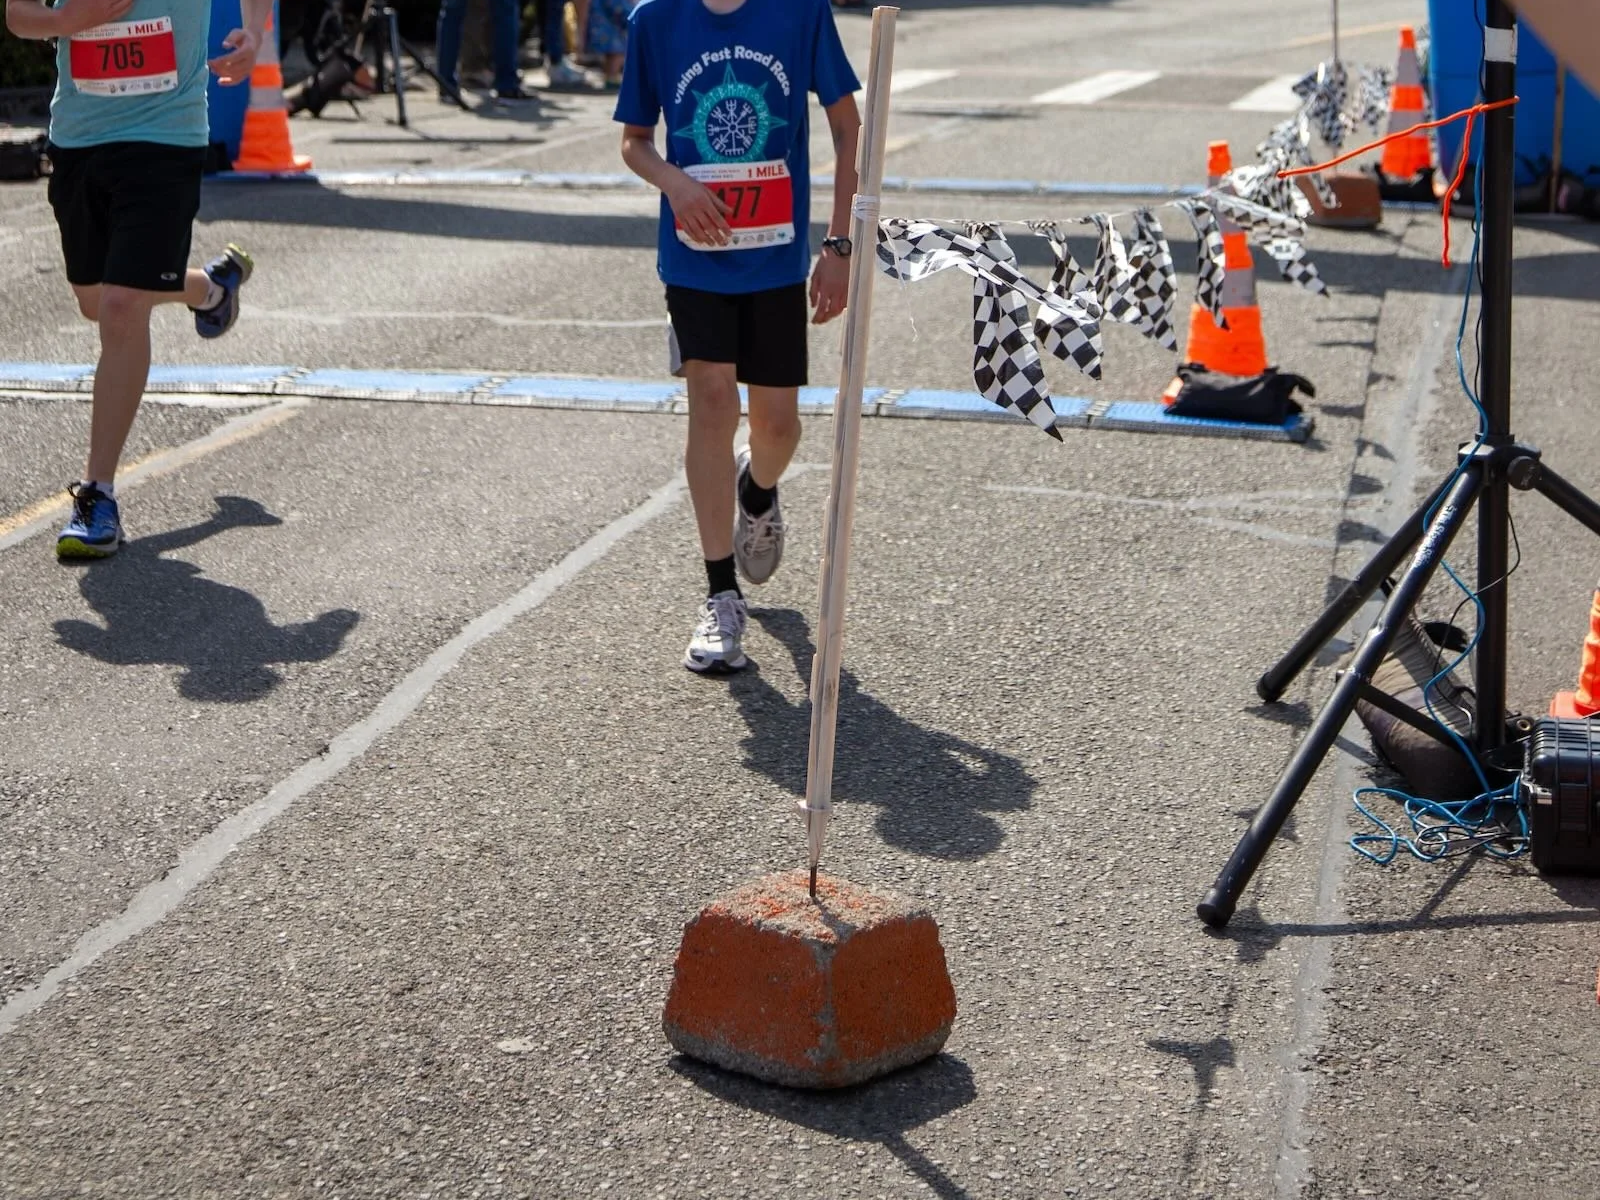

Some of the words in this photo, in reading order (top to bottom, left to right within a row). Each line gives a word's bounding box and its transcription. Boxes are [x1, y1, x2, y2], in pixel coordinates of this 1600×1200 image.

[135, 21, 164, 34] MILE
[96, 41, 145, 72] 705
[701, 47, 732, 67] Fest
[734, 45, 774, 67] Road
[769, 59, 791, 97] Race
[756, 165, 784, 178] MILE
